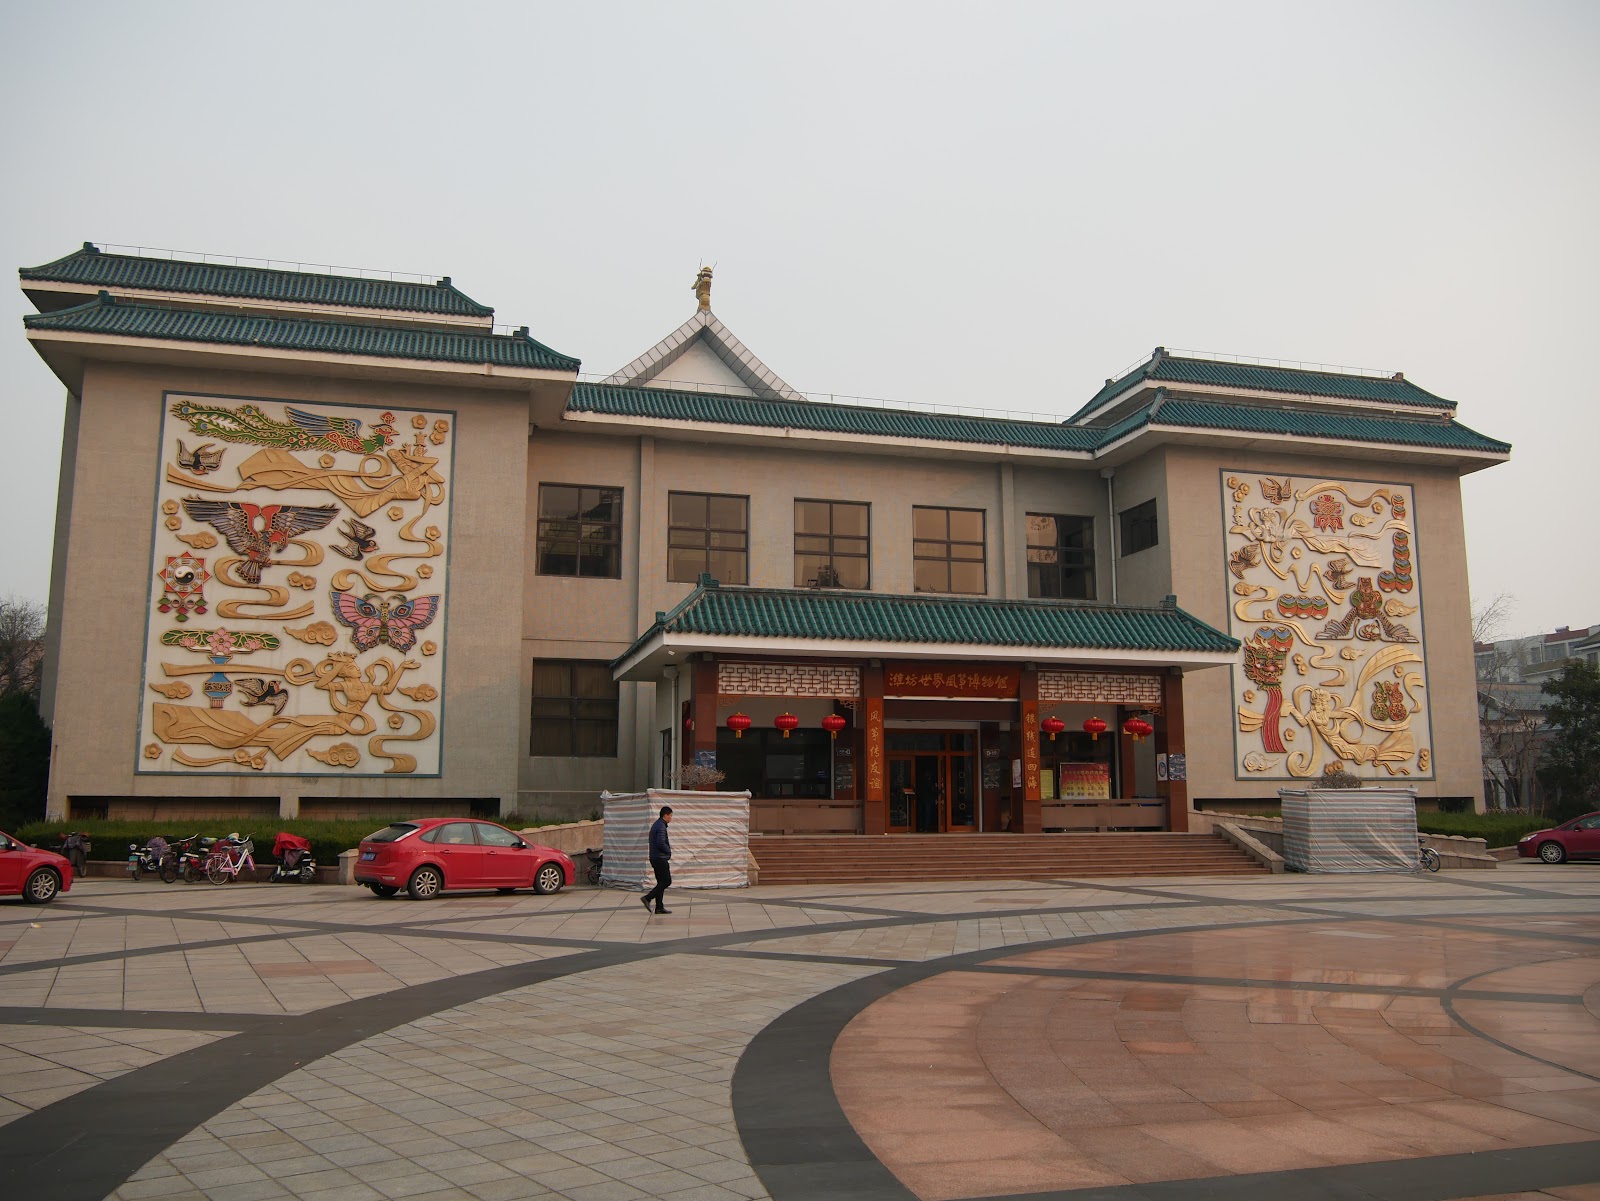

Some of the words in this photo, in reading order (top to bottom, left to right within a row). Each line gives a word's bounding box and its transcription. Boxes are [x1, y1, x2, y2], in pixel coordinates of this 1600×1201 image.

[868, 709, 881, 789] 风筝传友谊
[1025, 712, 1038, 789] 银线连四海
